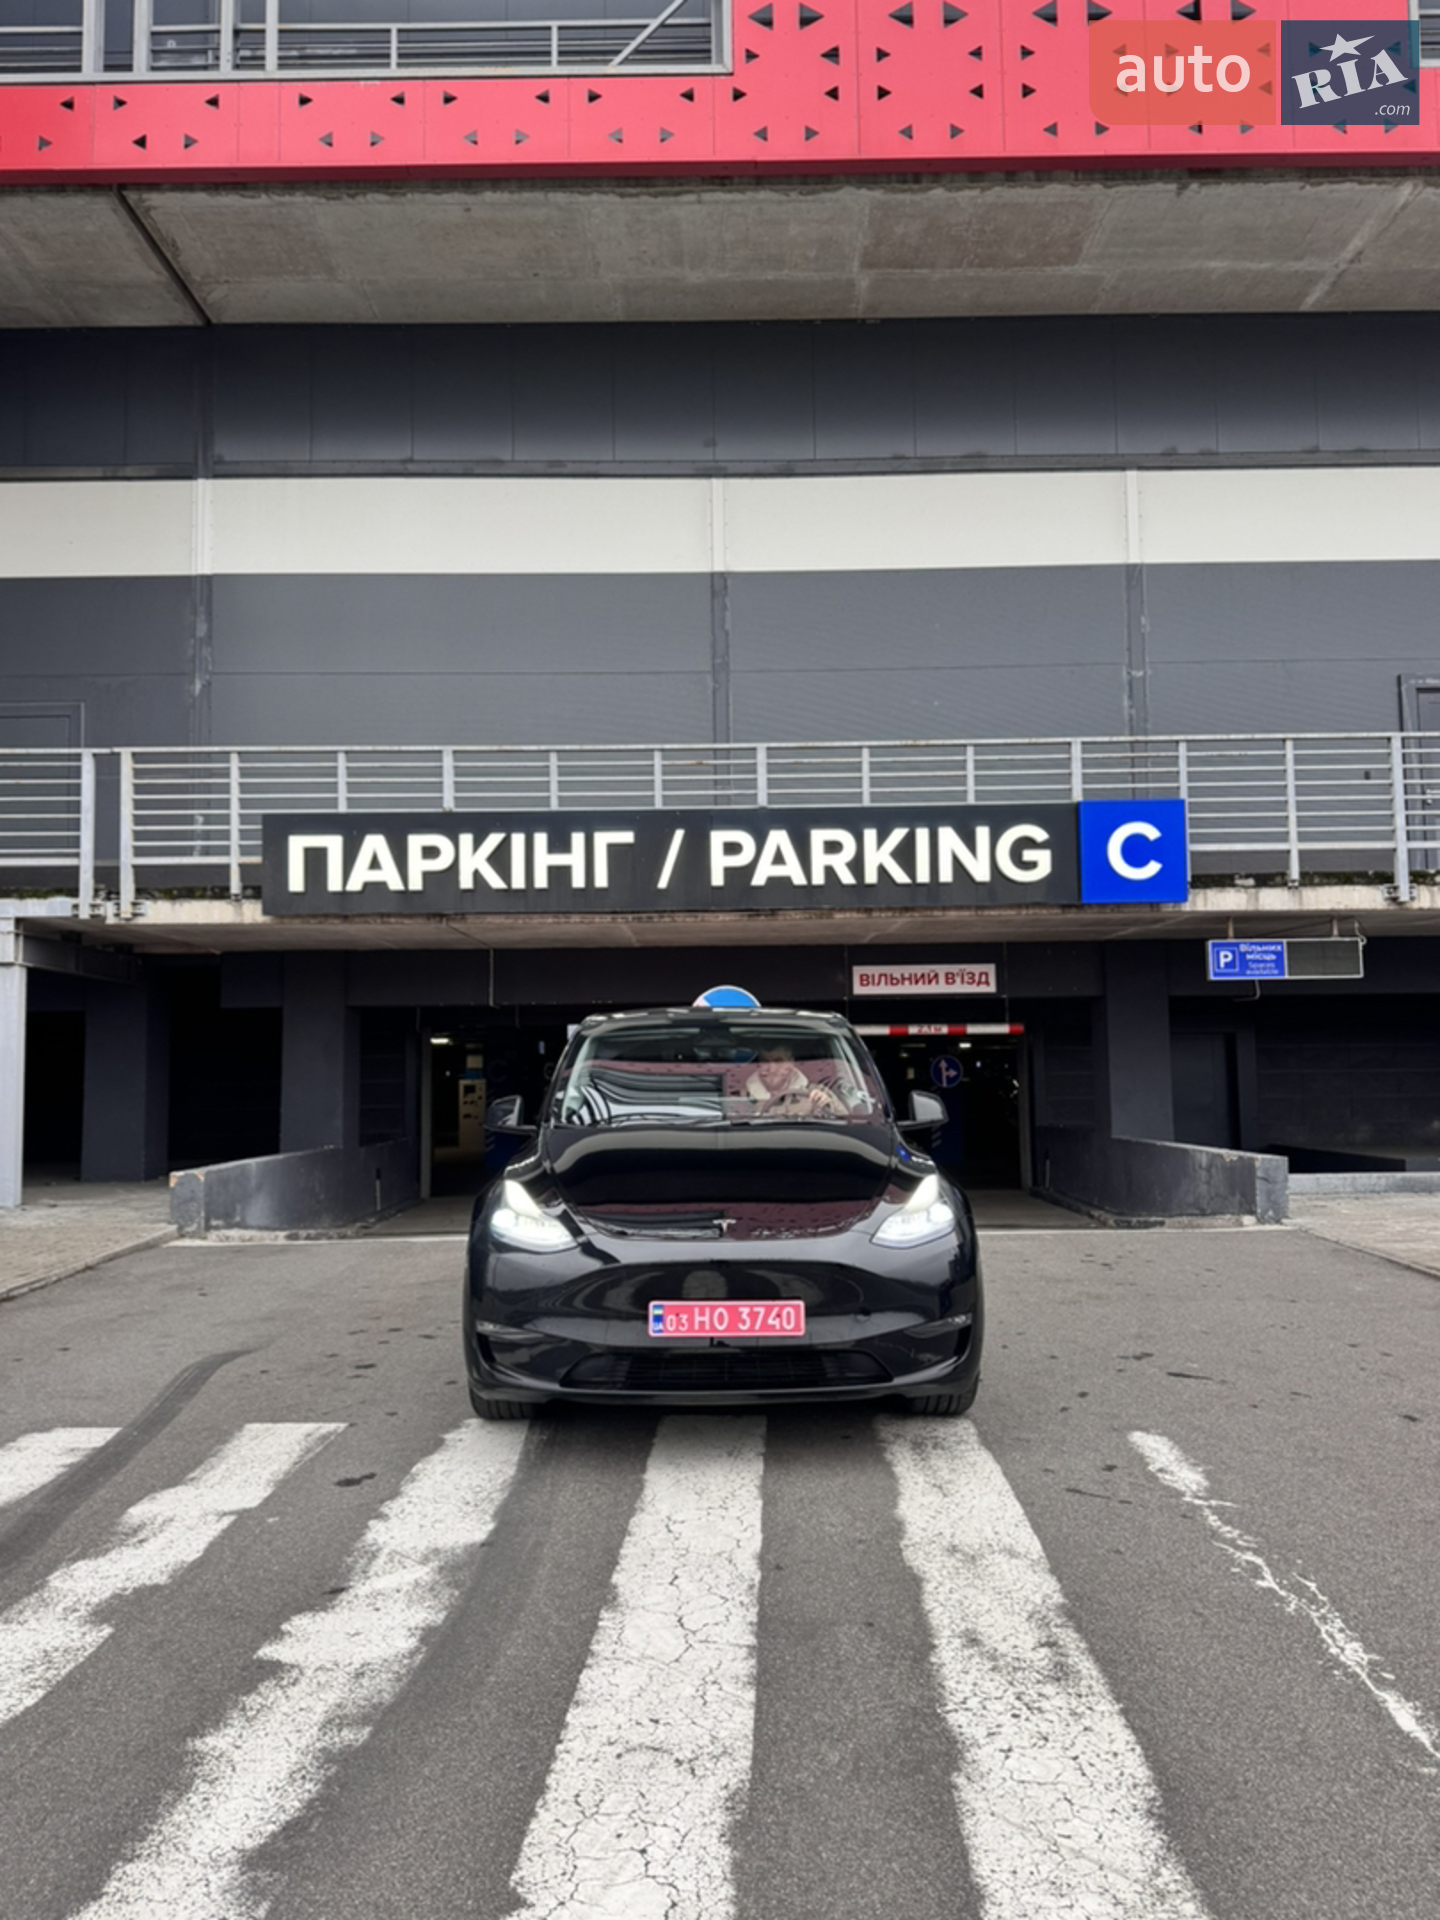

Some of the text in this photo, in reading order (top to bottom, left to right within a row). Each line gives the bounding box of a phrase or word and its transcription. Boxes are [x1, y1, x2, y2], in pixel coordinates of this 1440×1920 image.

[287, 830, 635, 893] ПАРКІНГ
[710, 821, 1163, 887] PARKING C
[1219, 950, 1233, 969] P
[859, 968, 990, 987] ВІЛЬНИЙ В'ЇЗД
[666, 1314, 689, 1331] 03
[737, 1307, 796, 1331] 3740
